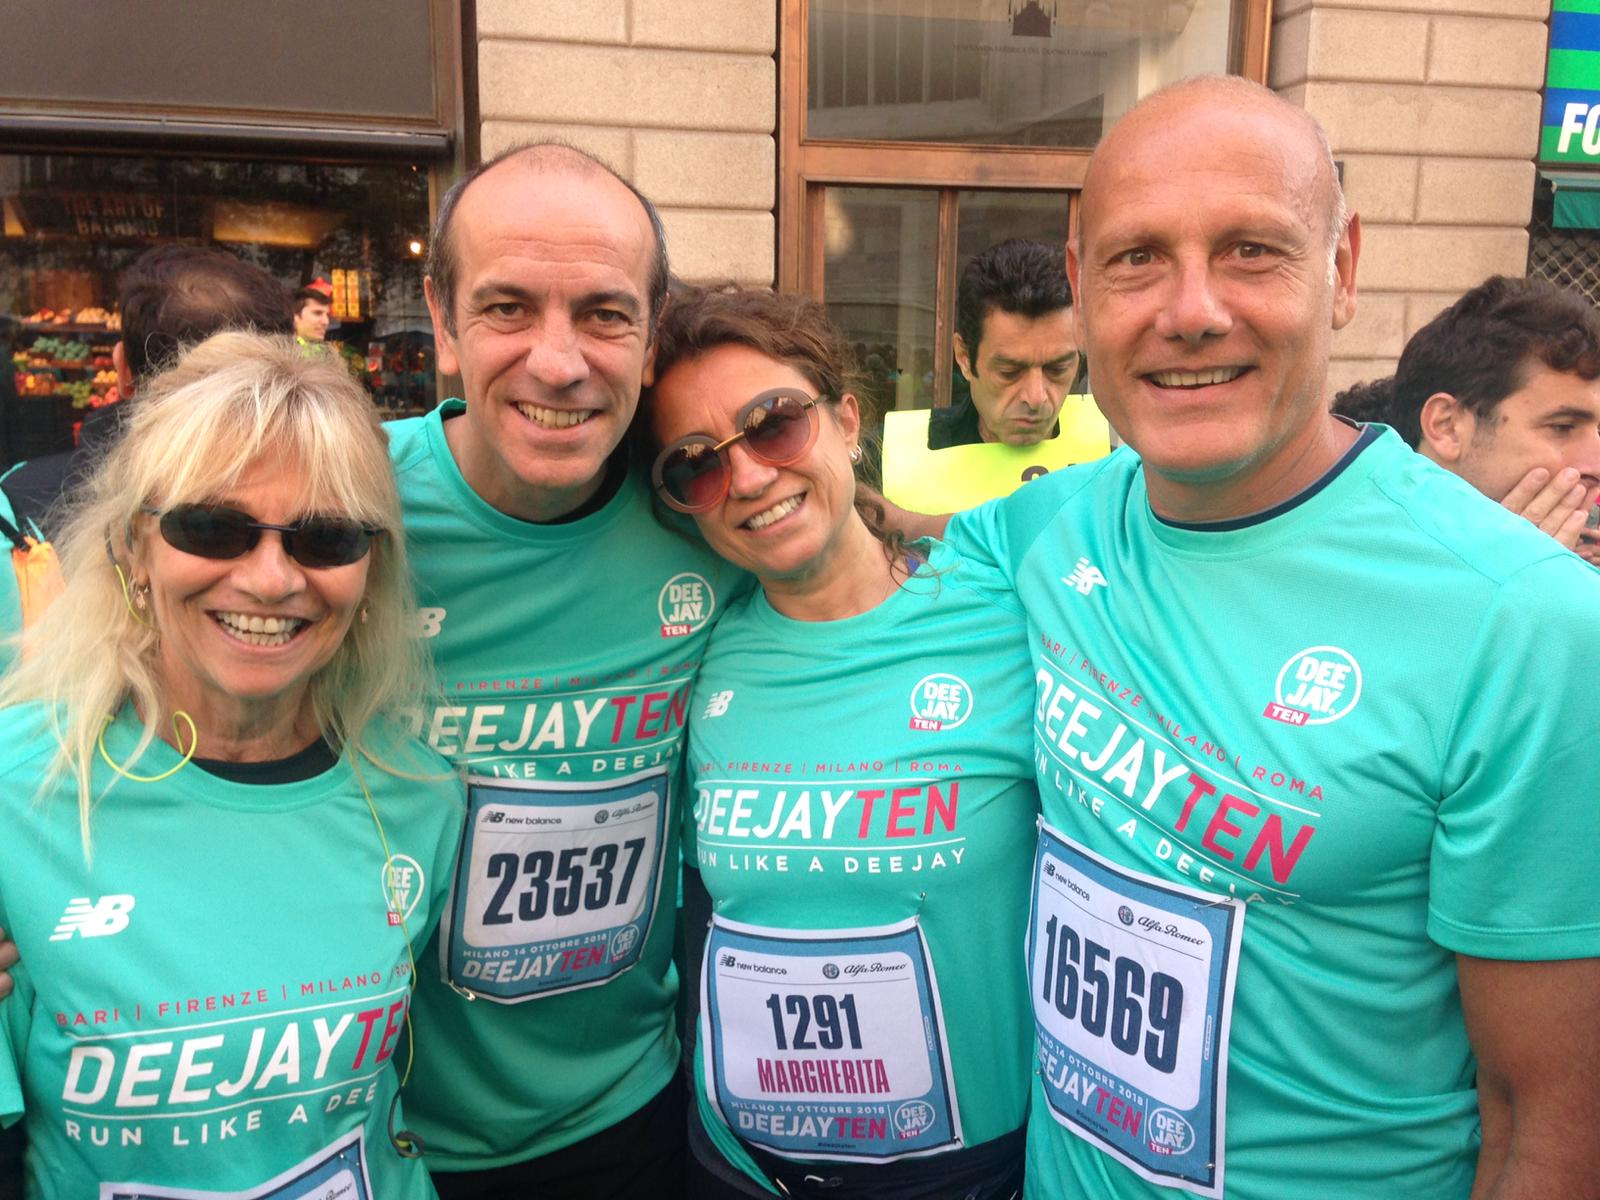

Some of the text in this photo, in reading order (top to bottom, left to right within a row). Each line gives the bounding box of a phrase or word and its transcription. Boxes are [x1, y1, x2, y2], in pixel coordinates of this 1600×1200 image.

[669, 583, 703, 604] DEE
[663, 625, 688, 637] TEN
[456, 678, 545, 692] FIRENZE
[1295, 656, 1351, 690] DEE
[923, 681, 962, 702] DEE
[913, 718, 938, 731] TEN
[1272, 705, 1305, 724] TEN
[1081, 659, 1143, 707] FIRENZE
[1156, 711, 1227, 762] MILANO
[1252, 766, 1324, 801] ROMA
[474, 762, 537, 778] IKE
[556, 762, 572, 775] A
[727, 762, 793, 773] FIRENZE
[815, 760, 884, 773] MILANO
[910, 761, 963, 773] ROMA
[1036, 667, 1317, 885] DEEJAYTEN
[695, 782, 960, 840] DEEJAYTEN
[1055, 770, 1105, 818] LIKE
[1116, 818, 1137, 840] A
[505, 816, 524, 825] new
[525, 815, 562, 825] balance
[729, 853, 789, 872] LIKE
[808, 856, 824, 872] A
[844, 848, 965, 873] DEEJAY
[482, 837, 646, 926] 23537
[1055, 873, 1068, 886] new
[1068, 878, 1090, 901] balance
[1138, 916, 1205, 946] Alfa Romeo
[463, 950, 510, 959] MILANO
[514, 948, 526, 956] 14
[530, 940, 580, 954] OTTOBRE
[462, 944, 607, 983] DEEJAYTEN
[737, 961, 752, 971] new
[753, 962, 788, 975] balance
[844, 962, 907, 977] Alfa Romeo
[56, 1008, 118, 1027] BARI
[158, 989, 268, 1017] FIRENZE
[301, 971, 382, 997] MILANO
[1042, 914, 1184, 1075] 16569
[766, 993, 863, 1050] 1291
[757, 1057, 891, 1094] MARGHERITA
[1056, 1045, 1144, 1106] 14 OTTOBRE 2018
[731, 1101, 885, 1115] MILANO 14 OTTOBRE 2018
[901, 1105, 926, 1119] DEE
[66, 1120, 142, 1146] RUN
[174, 1109, 263, 1146] LIKE
[288, 1104, 309, 1124] A
[738, 1110, 887, 1141] DEEJAYTEN
[1156, 1113, 1185, 1135] DEE
[1151, 1144, 1170, 1154] TEN
